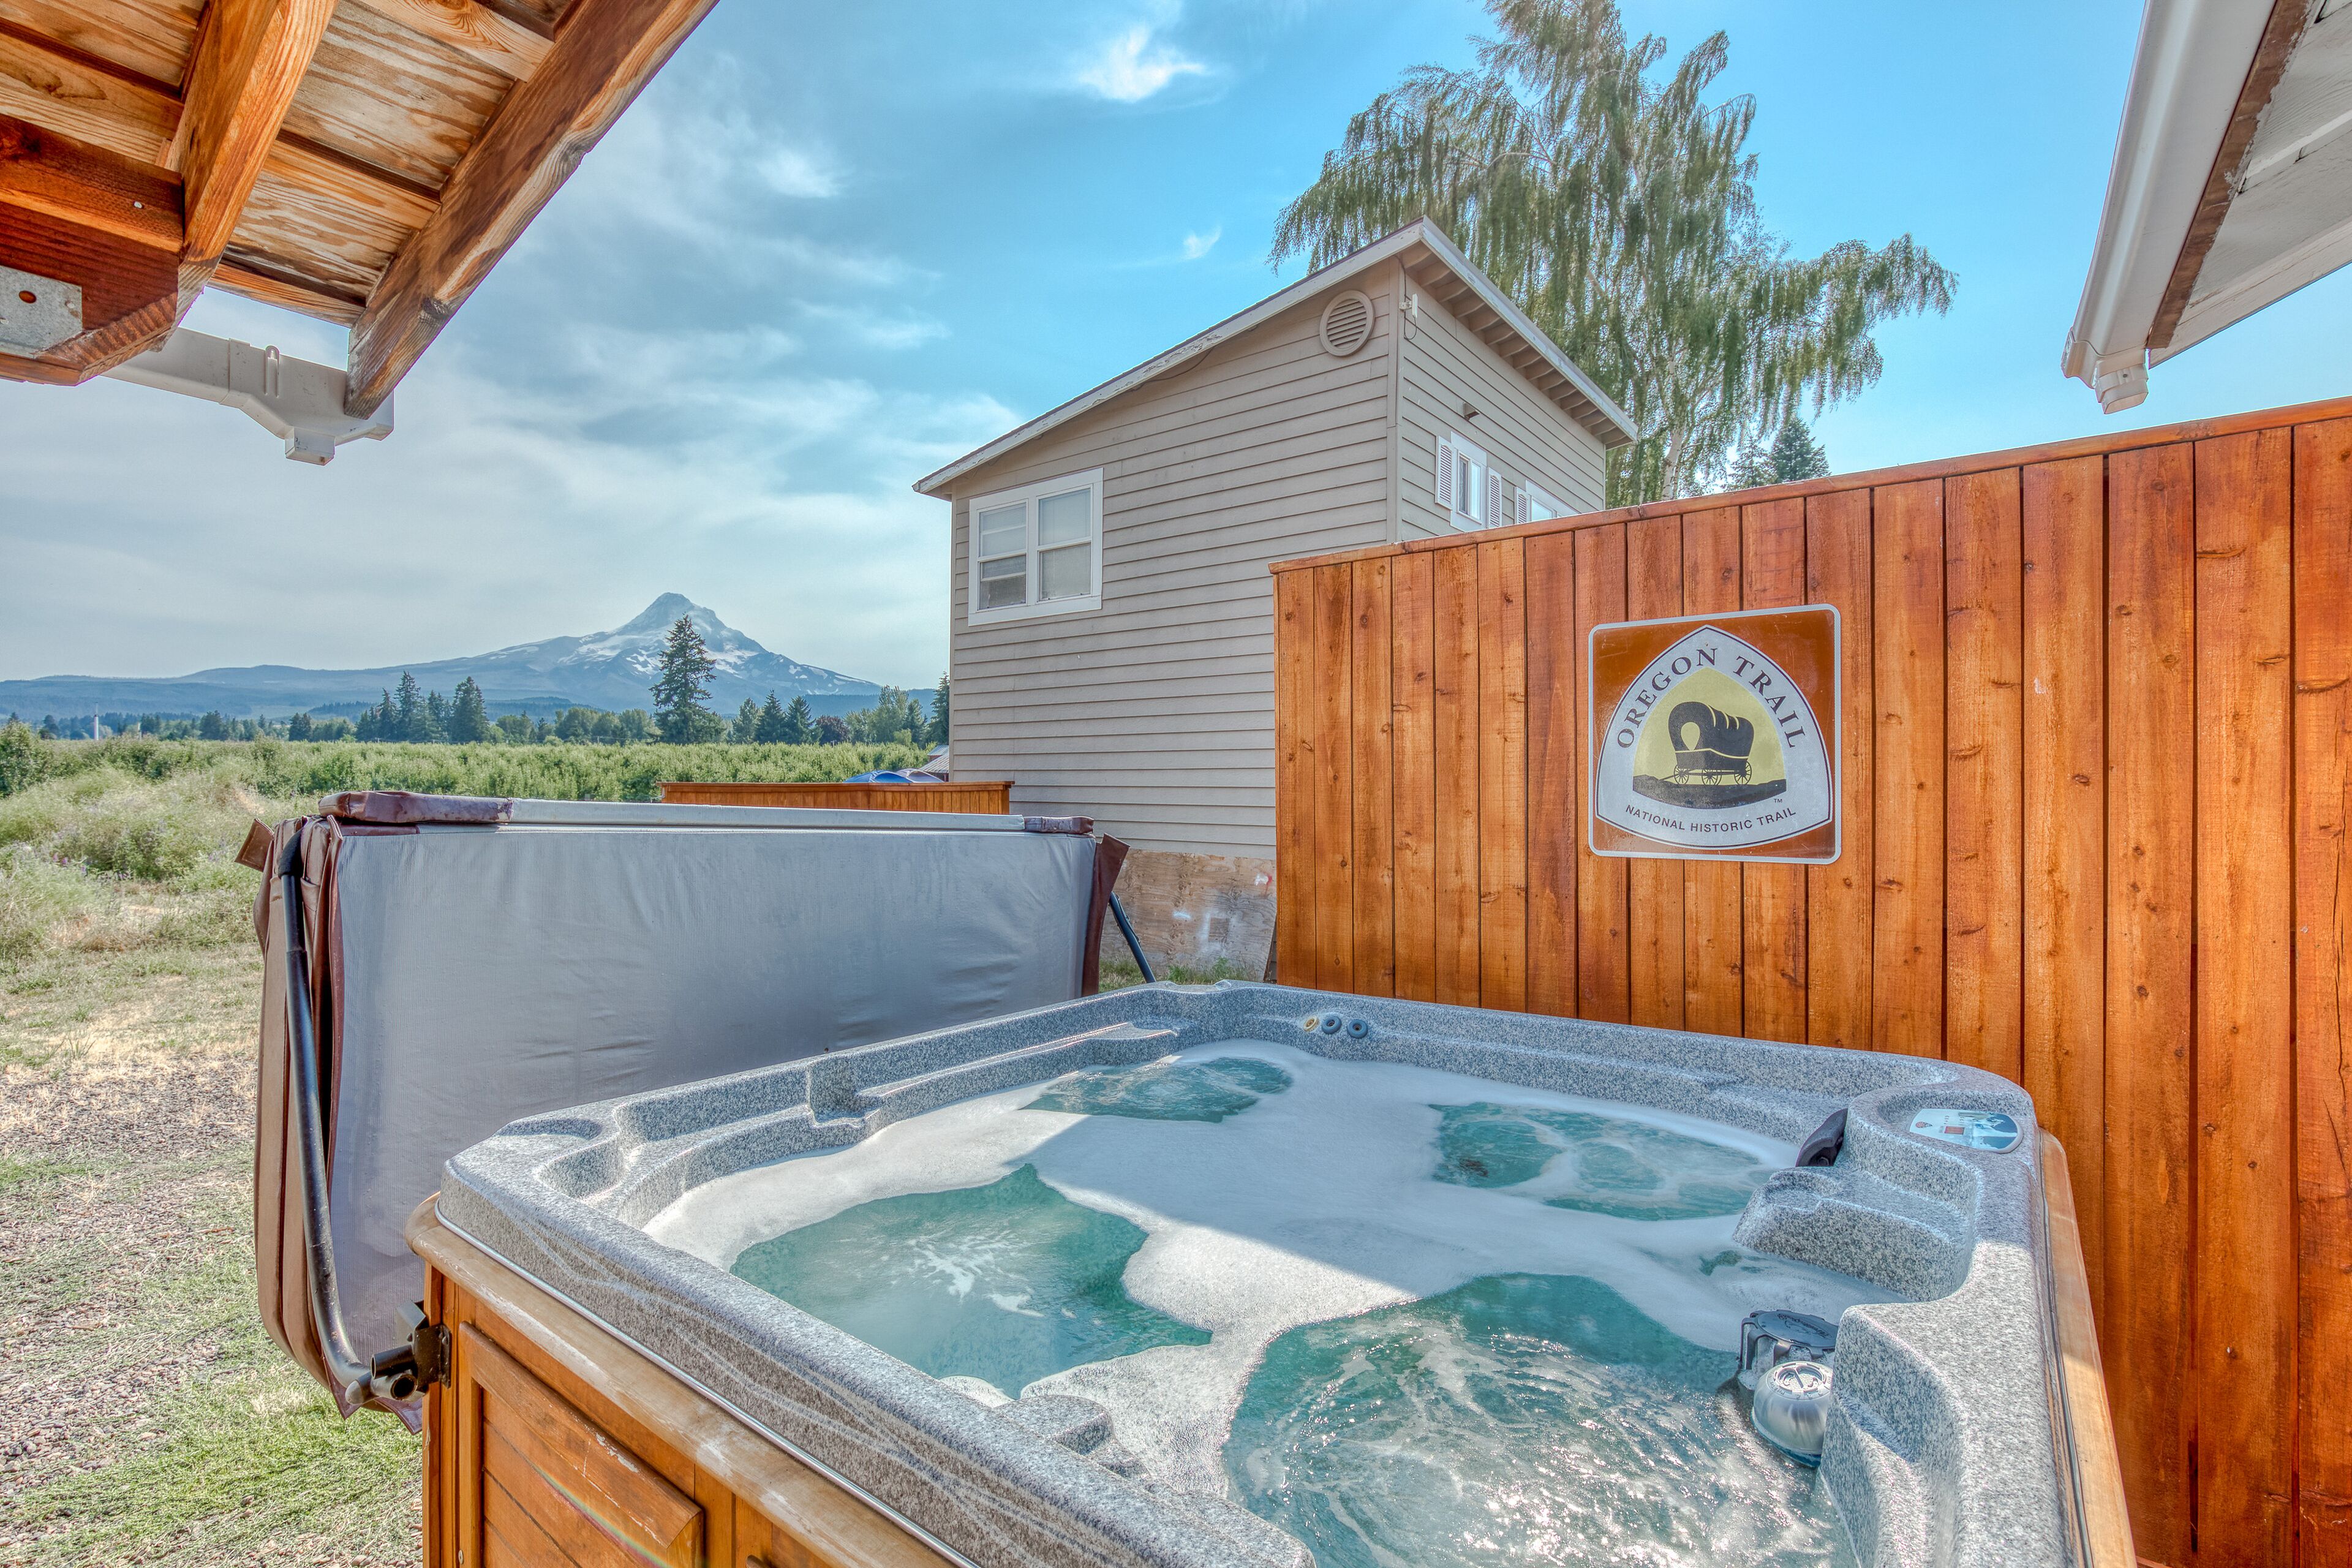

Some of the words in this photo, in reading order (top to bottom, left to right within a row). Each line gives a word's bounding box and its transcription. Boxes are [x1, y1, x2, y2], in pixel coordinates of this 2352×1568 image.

[1617, 647, 1718, 748] OREGON
[1733, 655, 1805, 748] TRAIL
[1625, 804, 1685, 831] NATIONAL
[1691, 820, 1752, 832] HISTORIC
[1759, 807, 1796, 826] TRAIL
